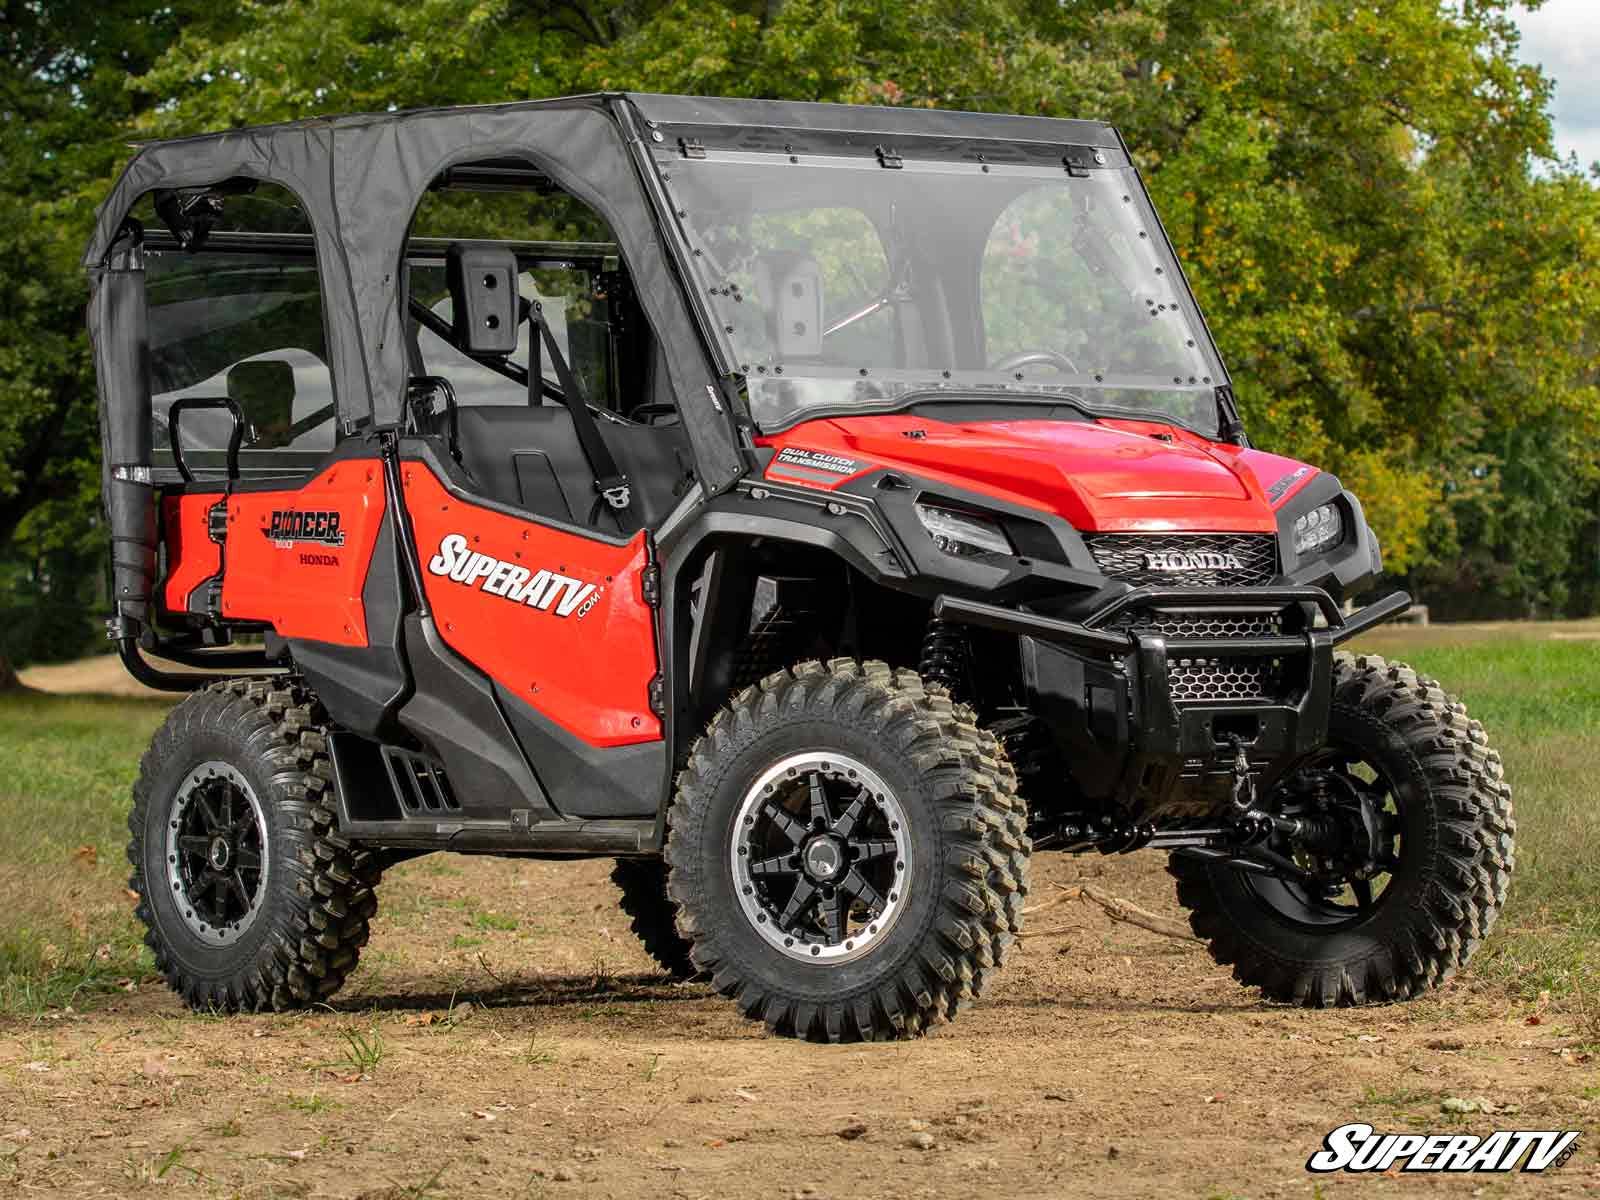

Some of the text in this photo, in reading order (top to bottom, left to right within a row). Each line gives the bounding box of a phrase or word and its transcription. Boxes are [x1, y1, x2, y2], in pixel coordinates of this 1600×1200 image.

[777, 453, 857, 475] TRANSMISSION
[782, 446, 856, 467] DUAL CLUTCH
[299, 553, 339, 567] HONDA
[1144, 553, 1244, 570] HONDA
